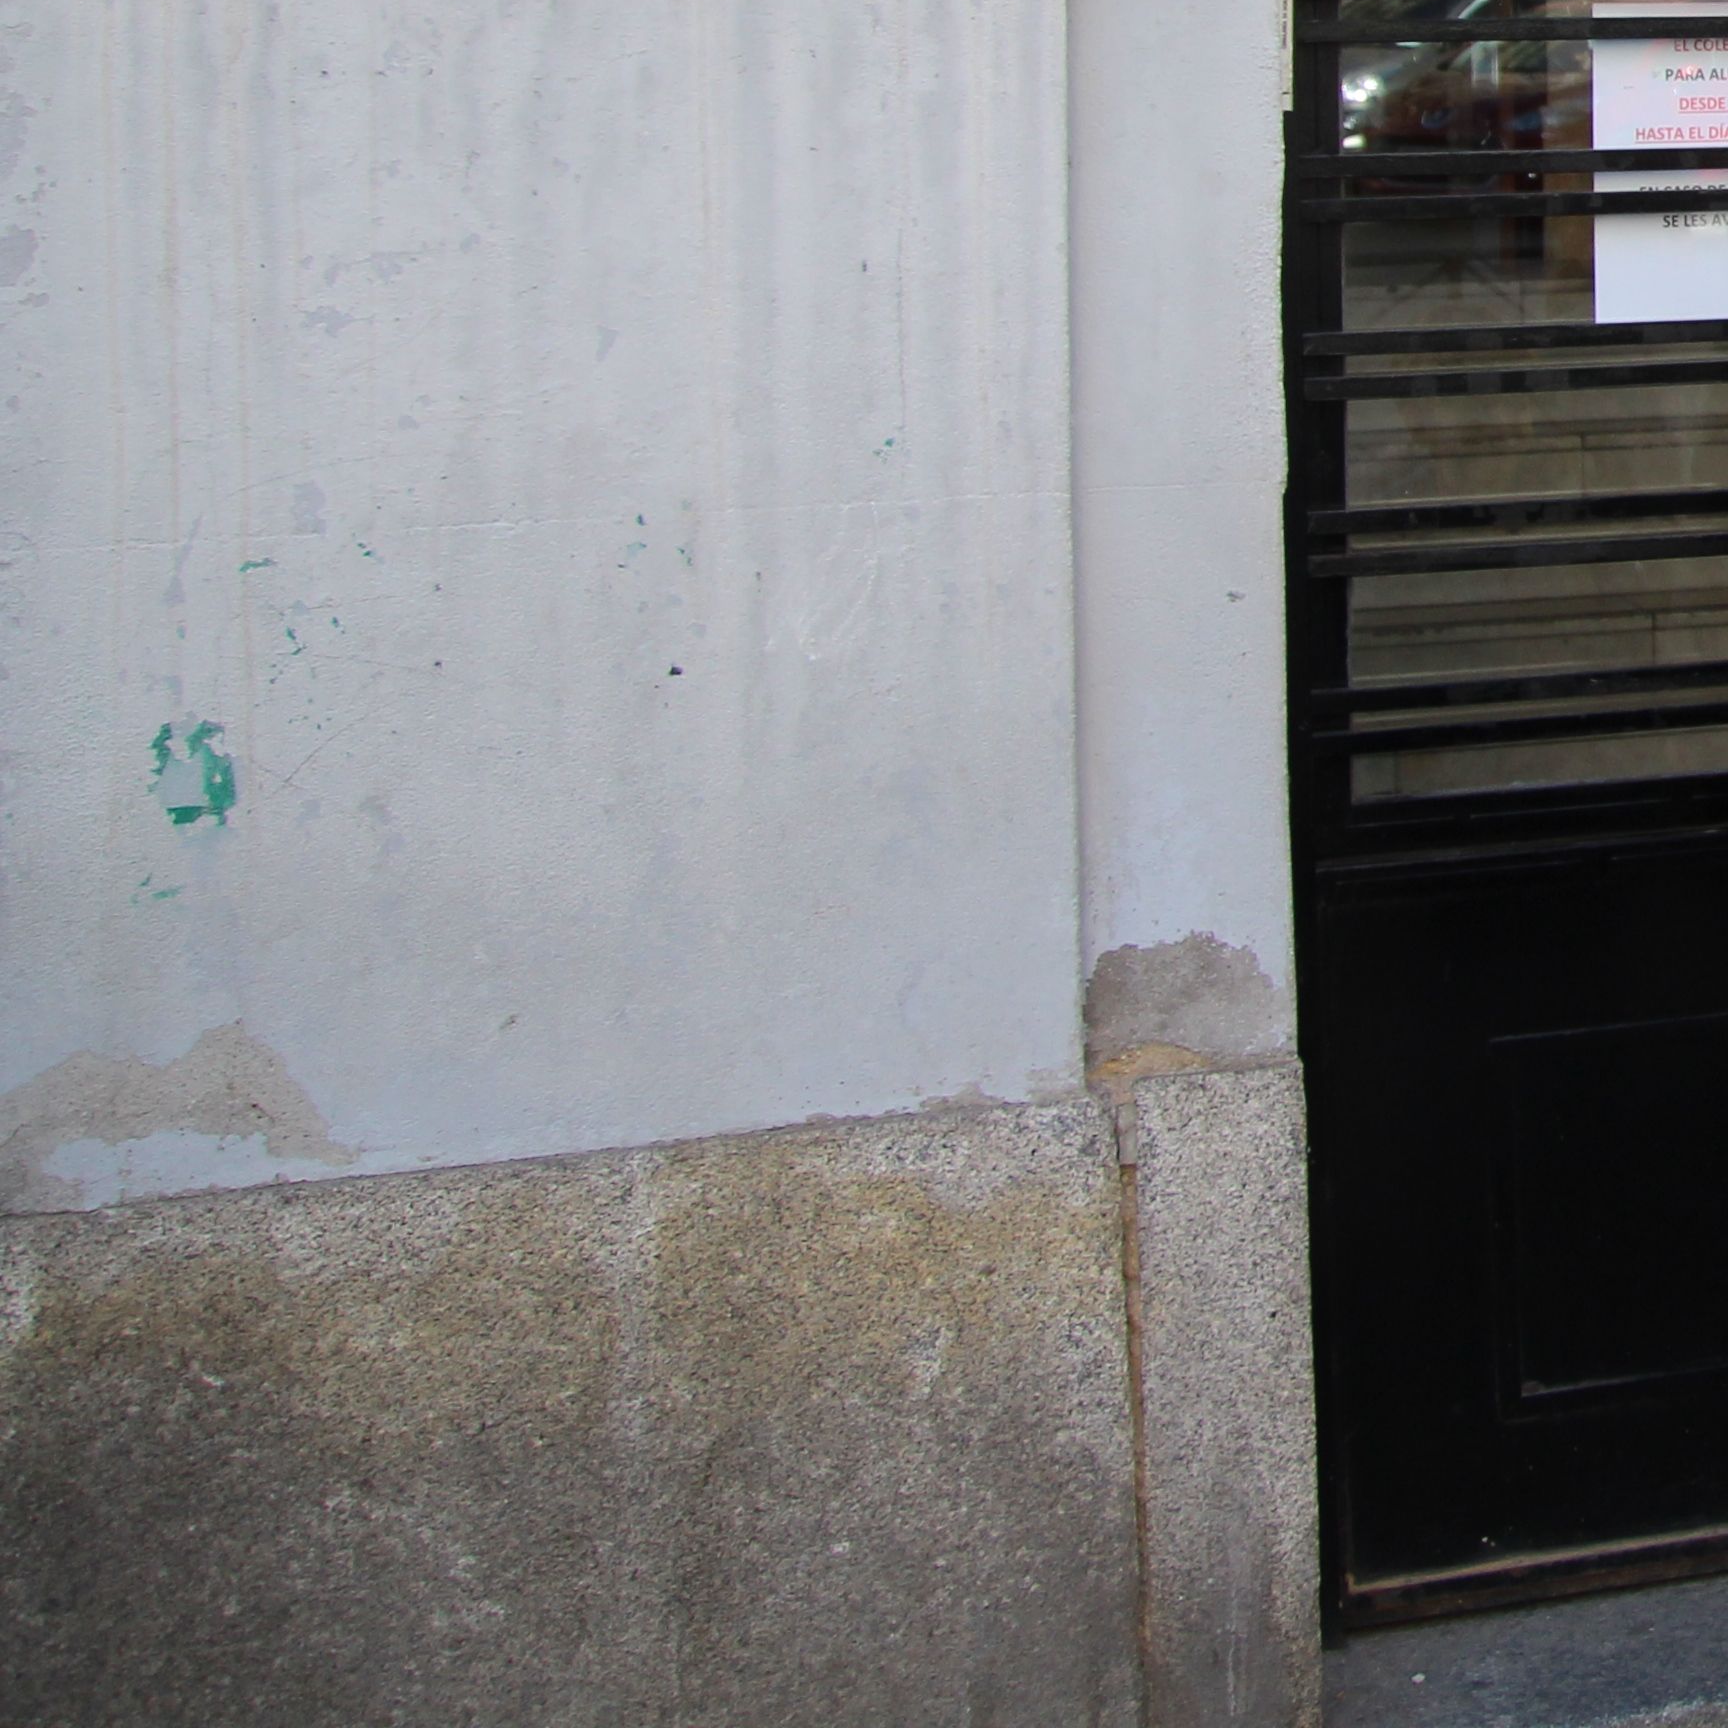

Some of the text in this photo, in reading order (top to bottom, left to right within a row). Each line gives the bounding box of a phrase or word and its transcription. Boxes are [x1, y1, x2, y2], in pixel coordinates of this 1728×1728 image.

[1674, 39, 1689, 52] EL
[1665, 66, 1705, 81] PARA
[1679, 96, 1725, 111] DESDE
[1635, 127, 1686, 141] HASTA
[1688, 126, 1704, 140] EL
[1662, 215, 1679, 228] SE
[1684, 214, 1707, 228] LES
